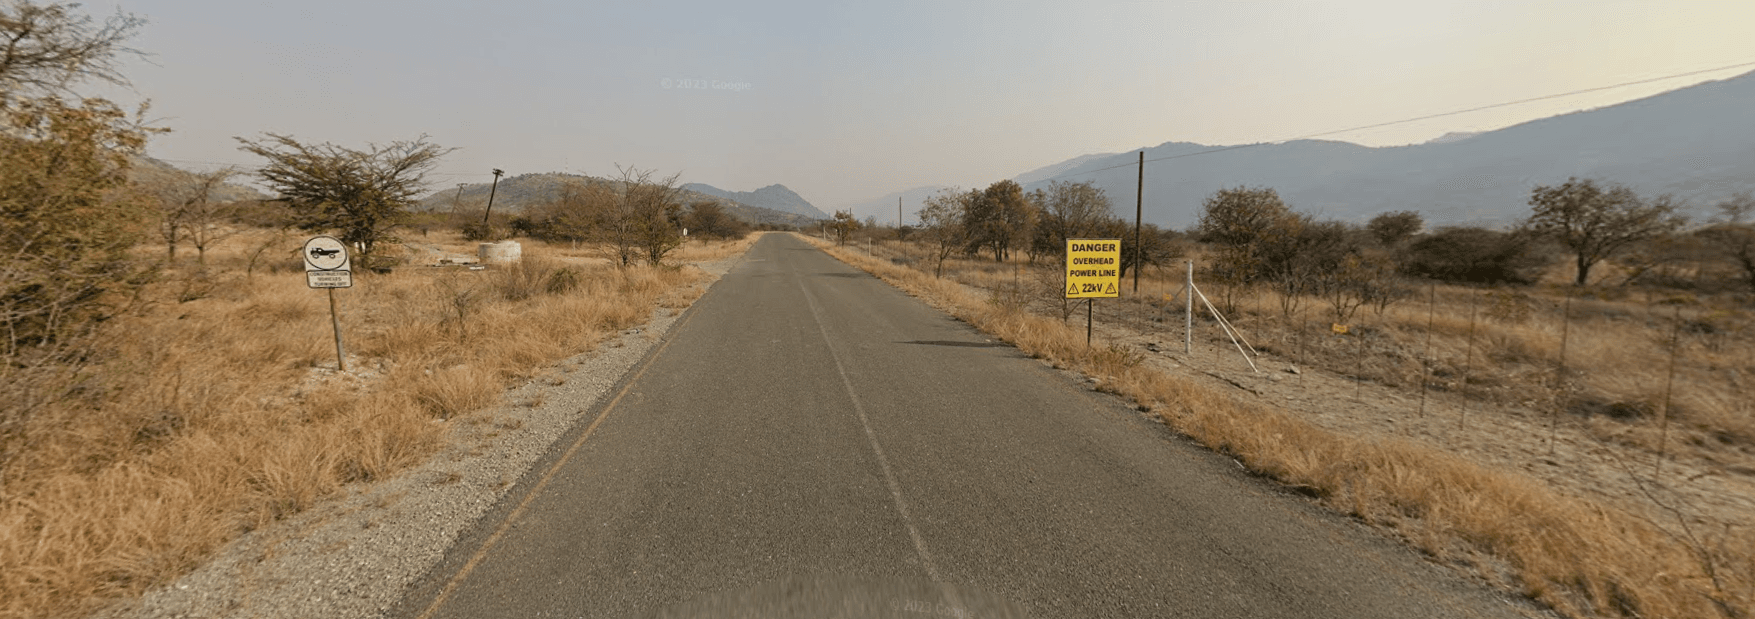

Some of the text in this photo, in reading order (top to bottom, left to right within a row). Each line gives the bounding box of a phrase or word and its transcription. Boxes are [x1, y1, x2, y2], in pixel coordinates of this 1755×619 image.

[1071, 243, 1116, 252] DANGER
[1073, 257, 1114, 265] OVERHEAD
[1070, 269, 1116, 277] POWER LINE
[1082, 283, 1103, 293] 22kV
